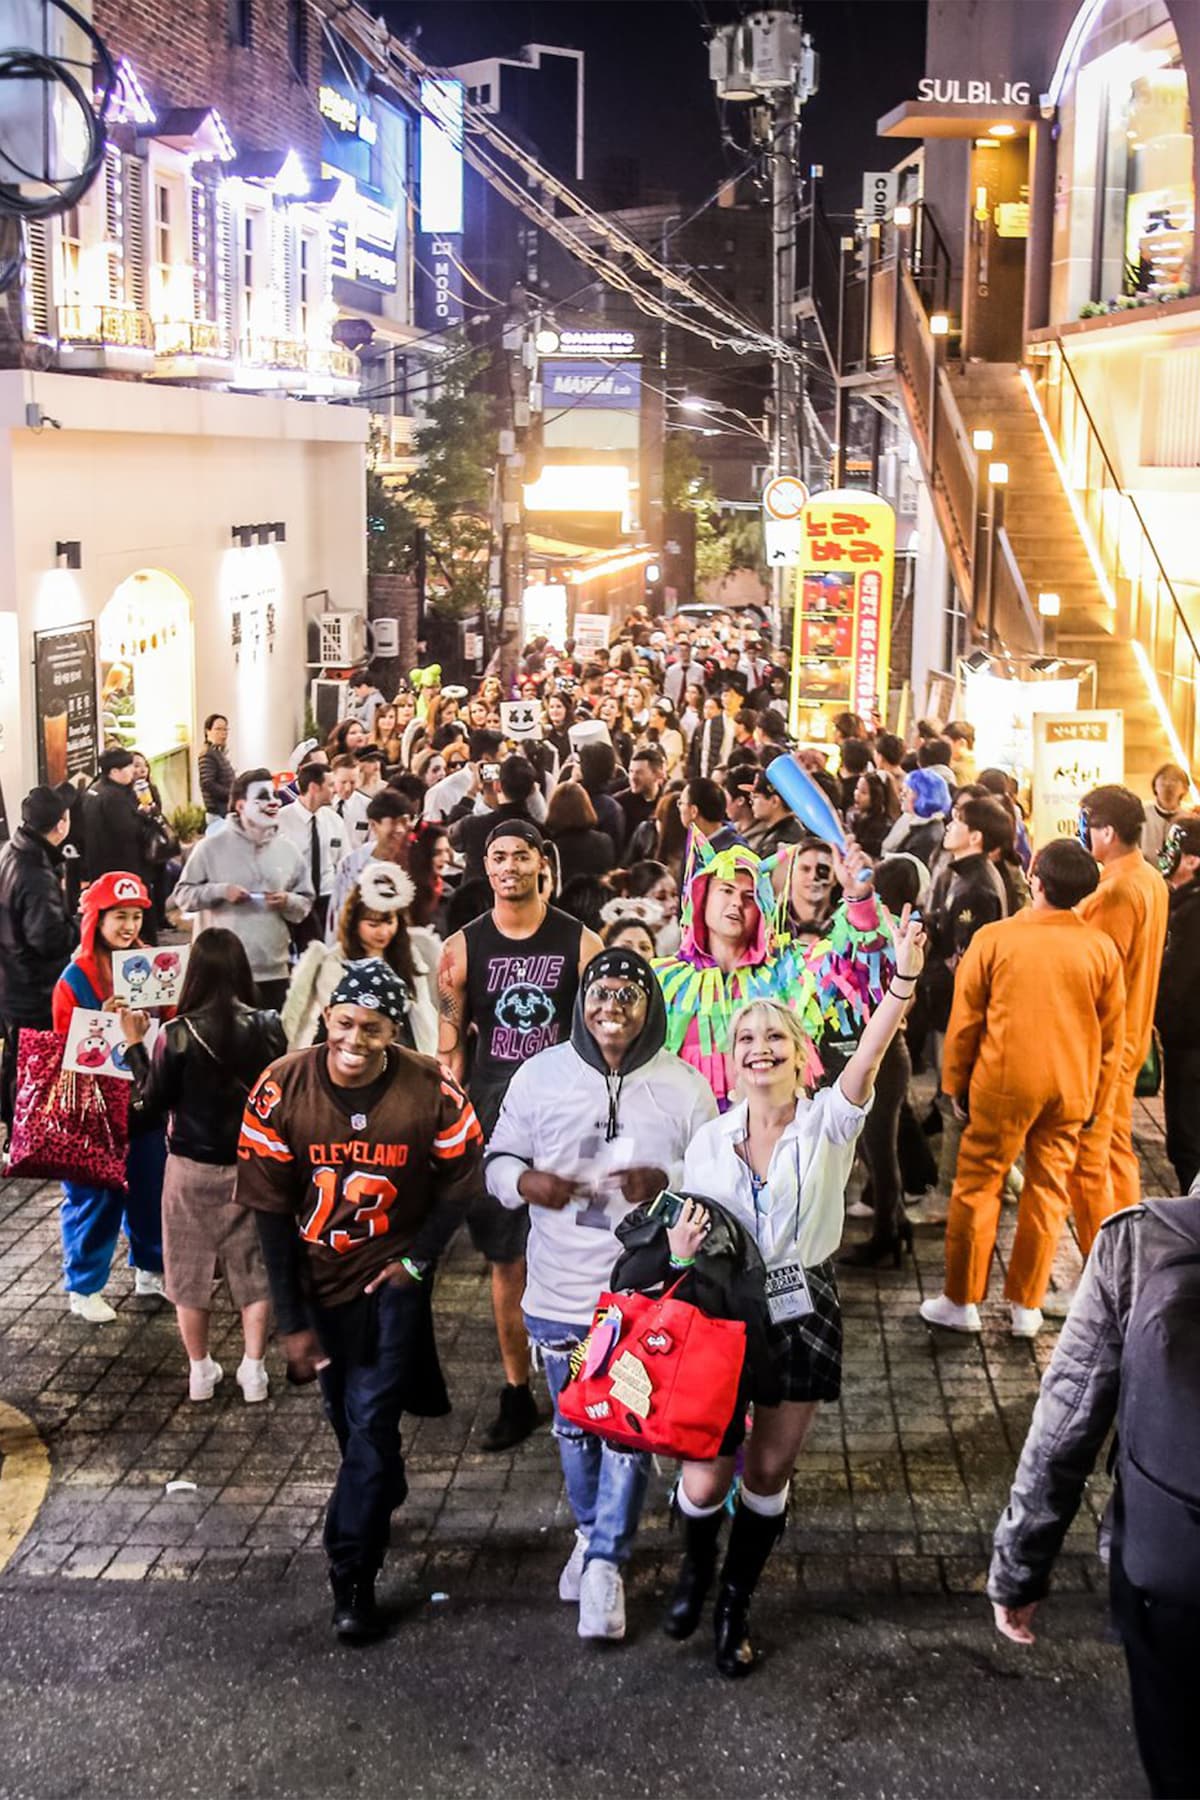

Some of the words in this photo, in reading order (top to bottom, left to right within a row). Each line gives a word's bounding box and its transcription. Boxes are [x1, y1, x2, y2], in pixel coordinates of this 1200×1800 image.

[118, 883, 139, 897] M
[487, 955, 565, 992] TRUE
[308, 1141, 409, 1166] CLEVELAND
[300, 1166, 398, 1254] 13
